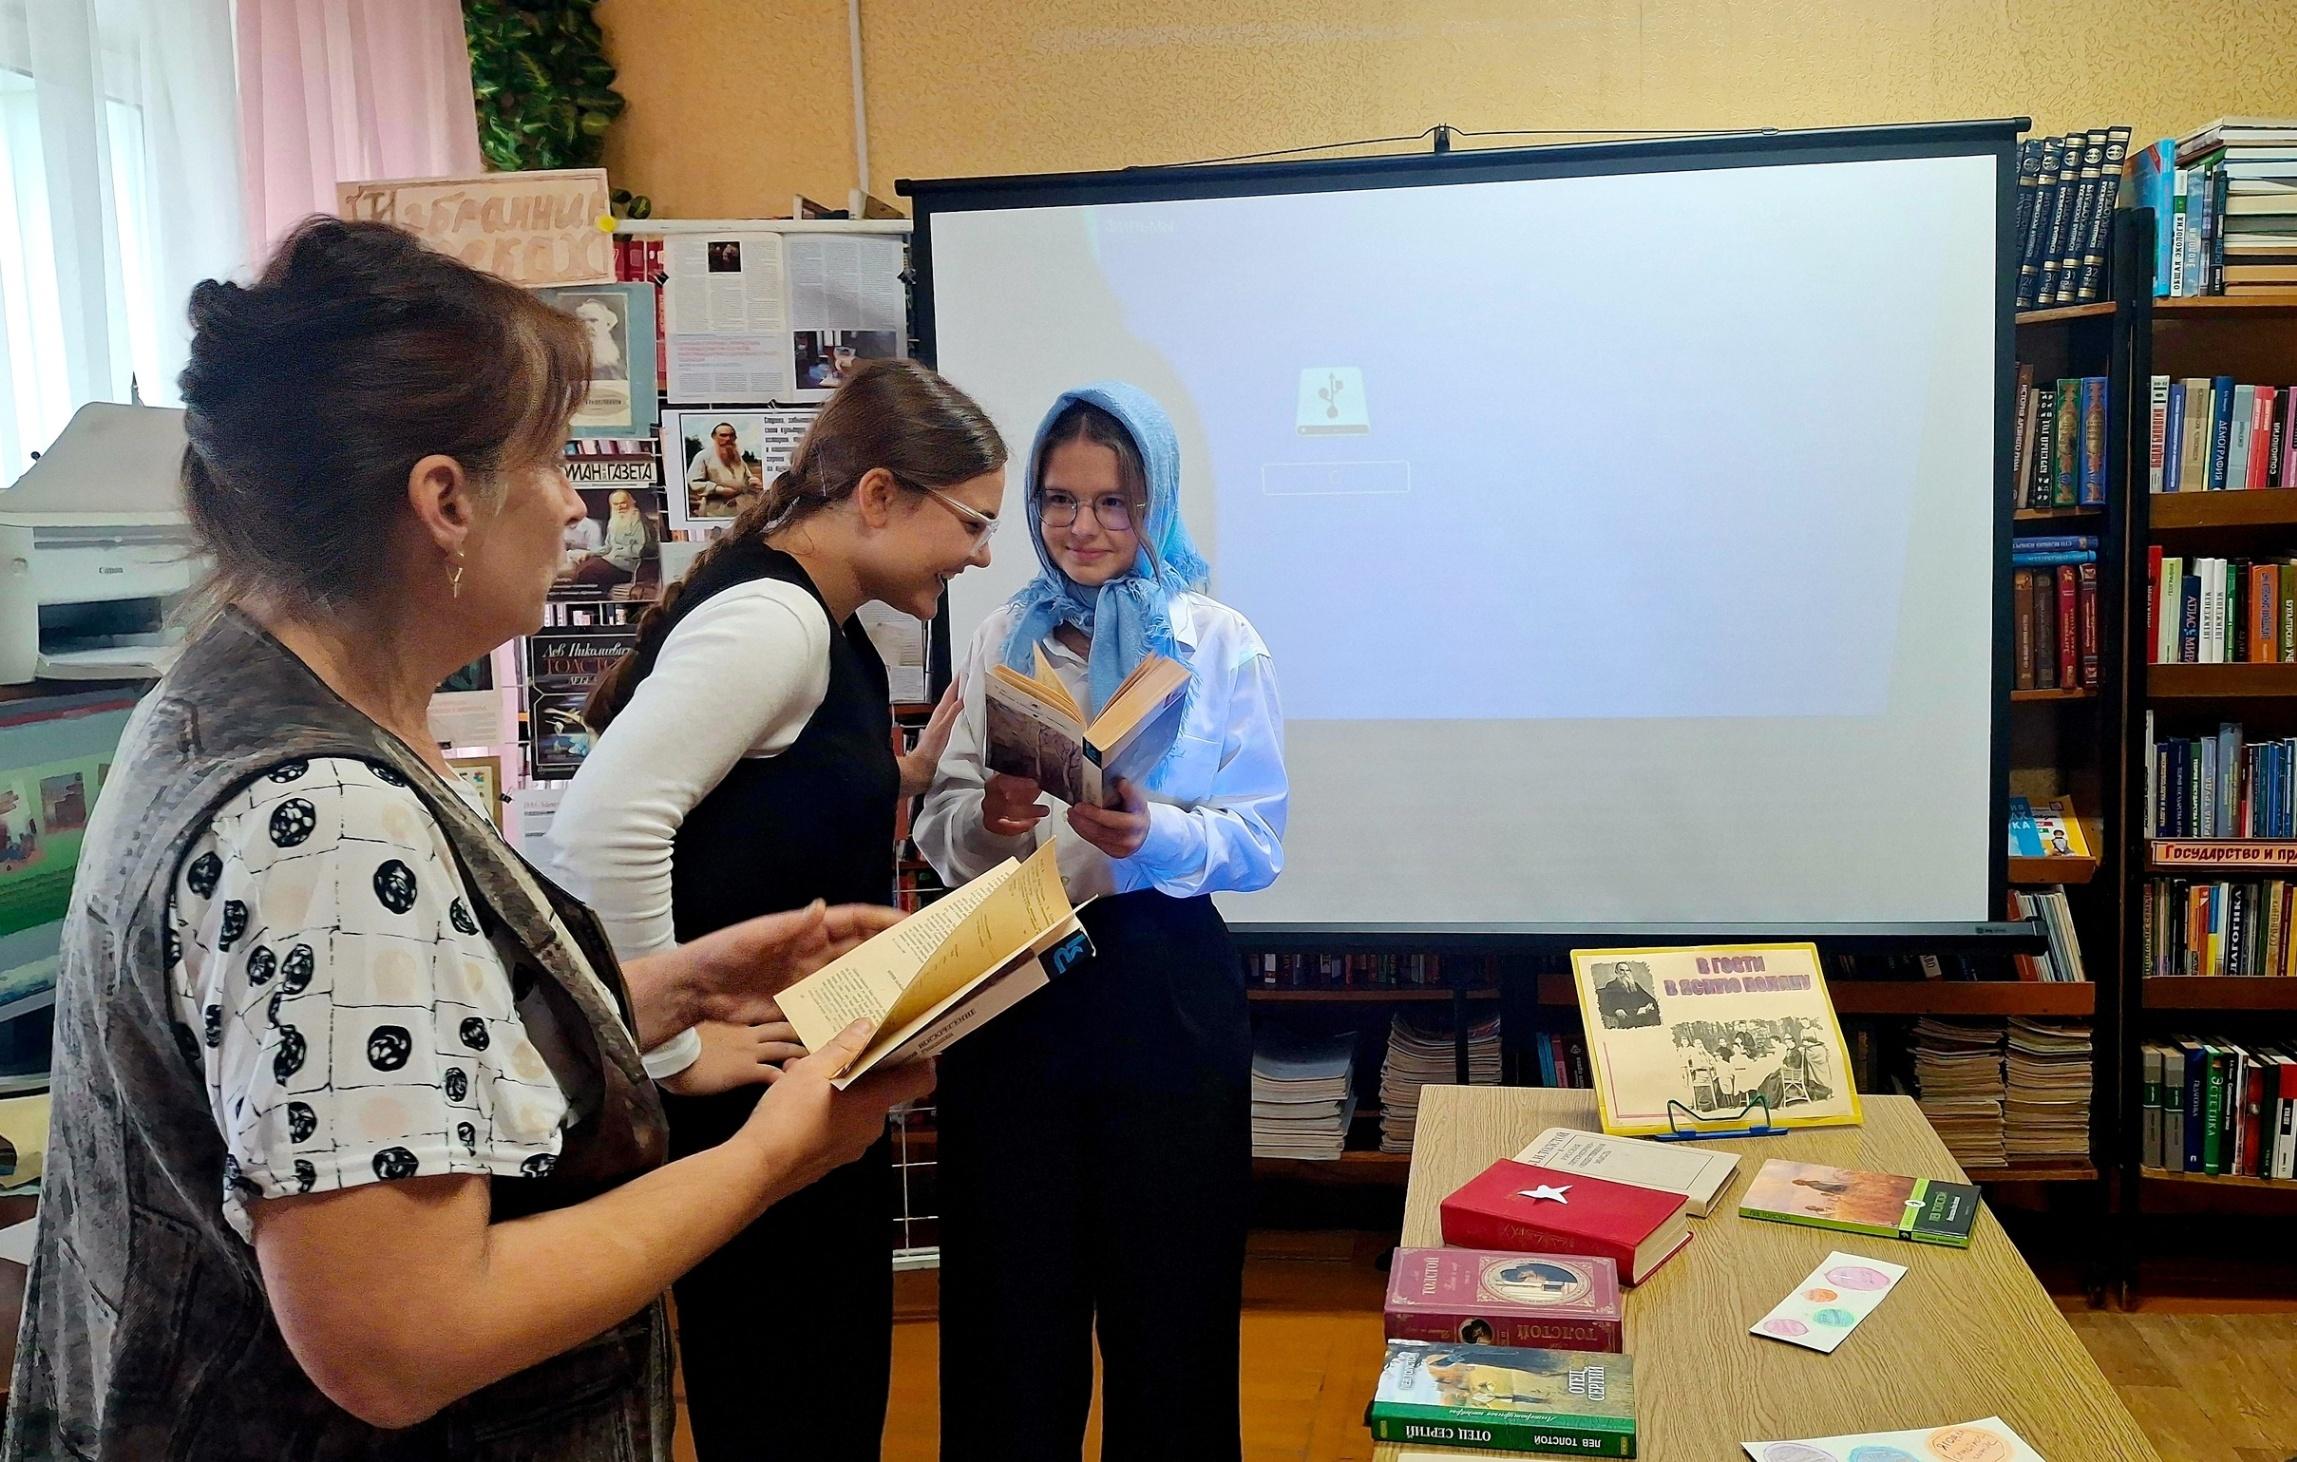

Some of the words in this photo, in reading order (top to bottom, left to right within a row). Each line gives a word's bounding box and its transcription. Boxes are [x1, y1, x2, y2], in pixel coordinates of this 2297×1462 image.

[2174, 216, 2184, 258] ЭКОЛОГИЯ
[2174, 261, 2183, 290] ОБЩАЯ
[2018, 384, 2027, 416] ИСТОРИЯ
[2152, 408, 2165, 443] БИОЛОГИЯ
[2151, 444, 2163, 468] ОБЩАЯ
[2214, 420, 2227, 481] ДЕМОГРАФИЯ
[2270, 422, 2281, 474] СОЦИОЛОГИЯ
[608, 463, 652, 480] ГАЗЕТА
[2187, 595, 2197, 628] АТЛАС
[2205, 777, 2213, 807] ТРУДА
[2204, 811, 2212, 837] РАНА
[2207, 1076, 2223, 1136] ЭСТЕТИКА
[1422, 1257, 1440, 1296] ТОЛСТОЙ
[1516, 1324, 1599, 1342] ТОЛСТОЙ
[1568, 1370, 1587, 1394] ОТЕЦ
[1587, 1366, 1605, 1401] СЕРГИЙ
[1405, 1425, 1454, 1440] СЕРГИЙ
[1457, 1427, 1492, 1442] ОТЕЦ
[1534, 1435, 1577, 1448] ТОЛСТОЙ
[1582, 1438, 1602, 1448] ЛЕВ
